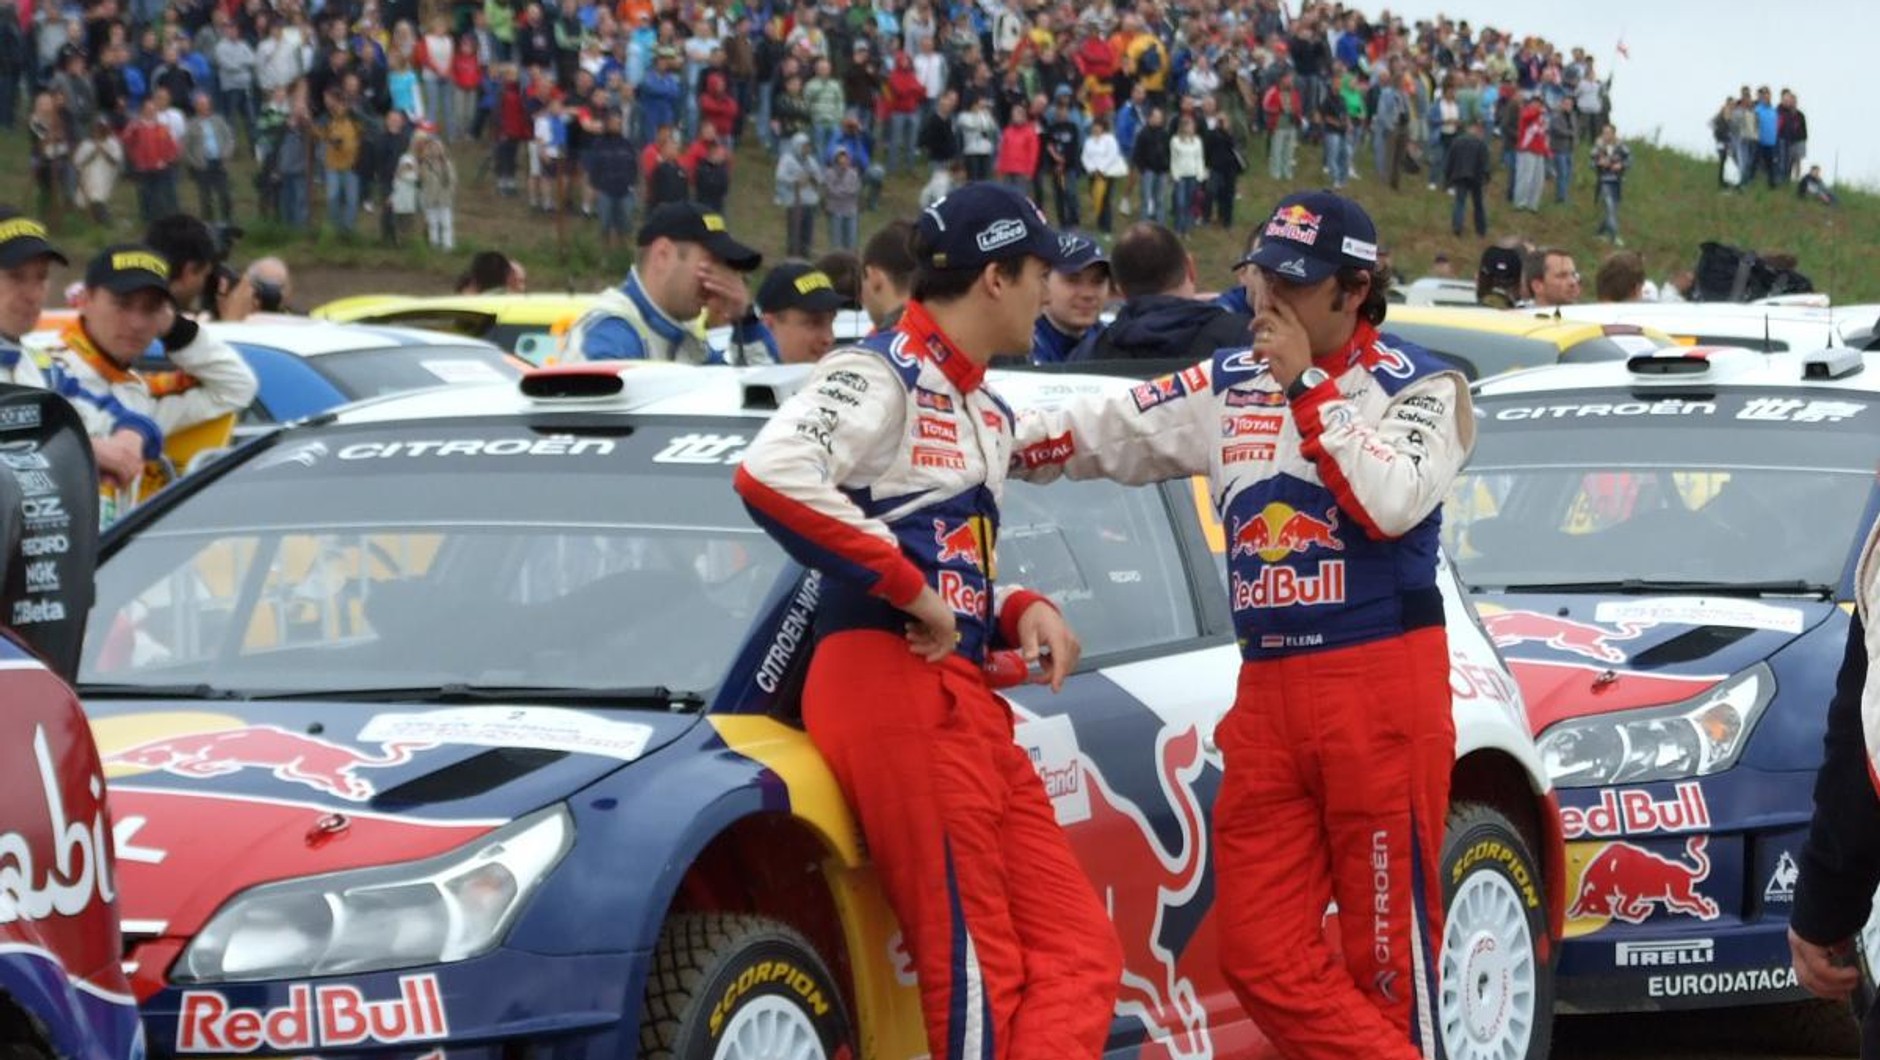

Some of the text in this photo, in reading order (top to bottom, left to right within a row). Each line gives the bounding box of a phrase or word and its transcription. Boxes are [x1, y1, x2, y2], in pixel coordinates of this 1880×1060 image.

[920, 419, 957, 440] TOTAL
[1238, 418, 1279, 433] TOTAL
[1030, 444, 1071, 463] TOTAL
[22, 498, 64, 518] OZ
[26, 561, 59, 584] NGK
[1270, 560, 1345, 608] Bull
[1287, 634, 1323, 646] ELENA
[1560, 782, 1711, 838] ed Bull
[1452, 841, 1539, 908] SCORPION
[1615, 938, 1714, 966] PIRELLI
[1649, 967, 1799, 996] EURODATACA
[176, 972, 449, 1053] Red Bull
[709, 961, 829, 1038] SCORPION
